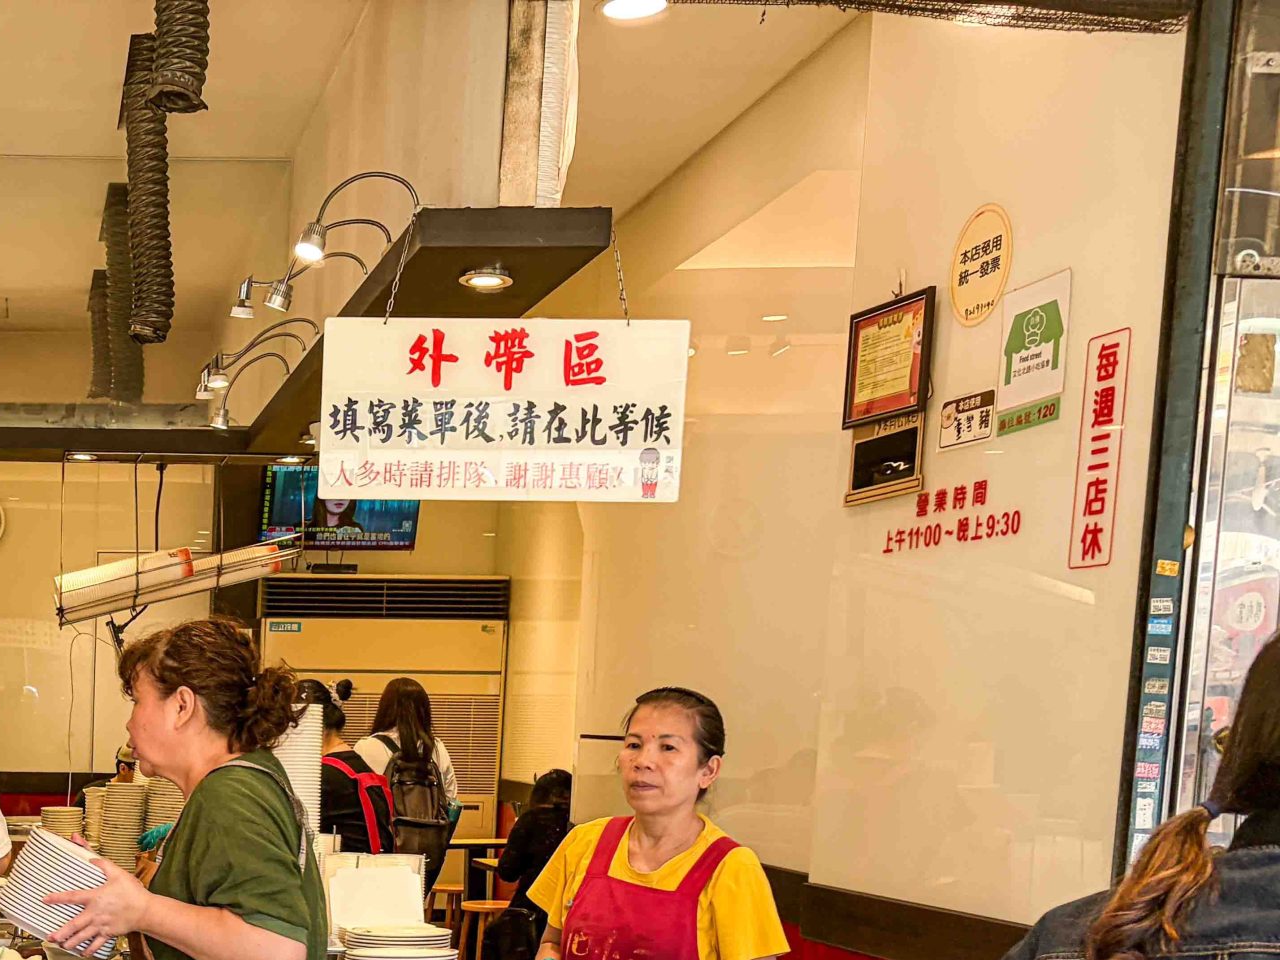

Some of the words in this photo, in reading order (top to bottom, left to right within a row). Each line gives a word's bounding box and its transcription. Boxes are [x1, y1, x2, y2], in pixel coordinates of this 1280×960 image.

[959, 234, 1003, 266] 本店免用
[958, 255, 1001, 287] 統一發票
[406, 328, 607, 391] 外帶區
[1081, 342, 1120, 562] 每週三店休
[916, 480, 987, 517] 營業時間
